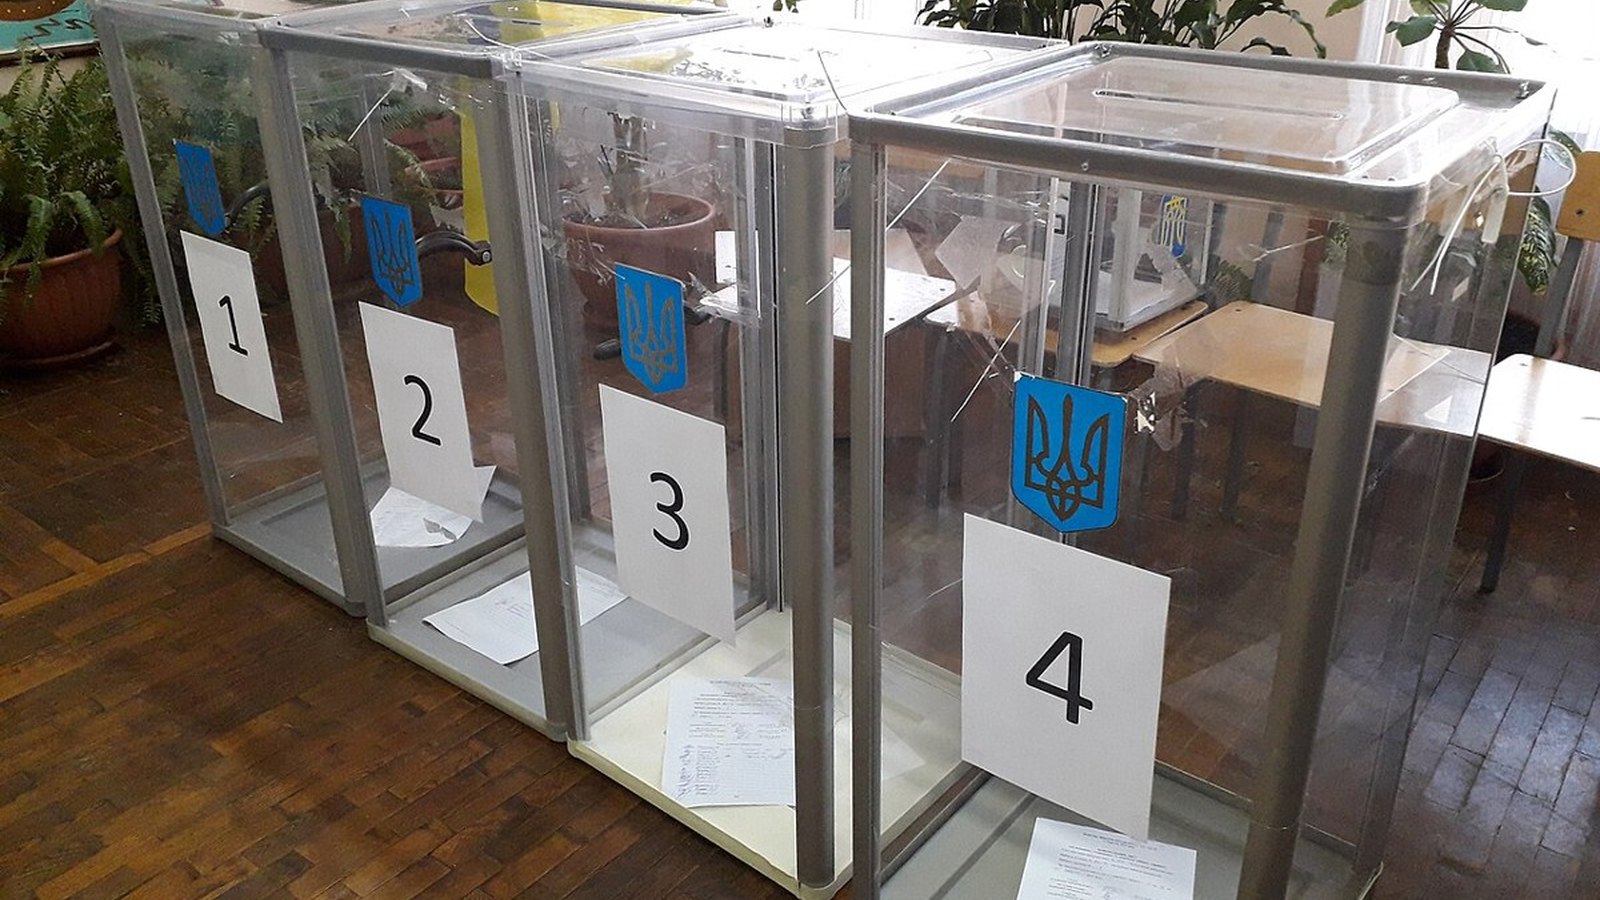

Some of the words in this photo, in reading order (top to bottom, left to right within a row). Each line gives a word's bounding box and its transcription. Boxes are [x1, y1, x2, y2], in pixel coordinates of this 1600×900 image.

[218, 295, 249, 357] 1
[403, 374, 442, 447] 2
[649, 472, 690, 551] 3
[1025, 631, 1094, 725] 4
